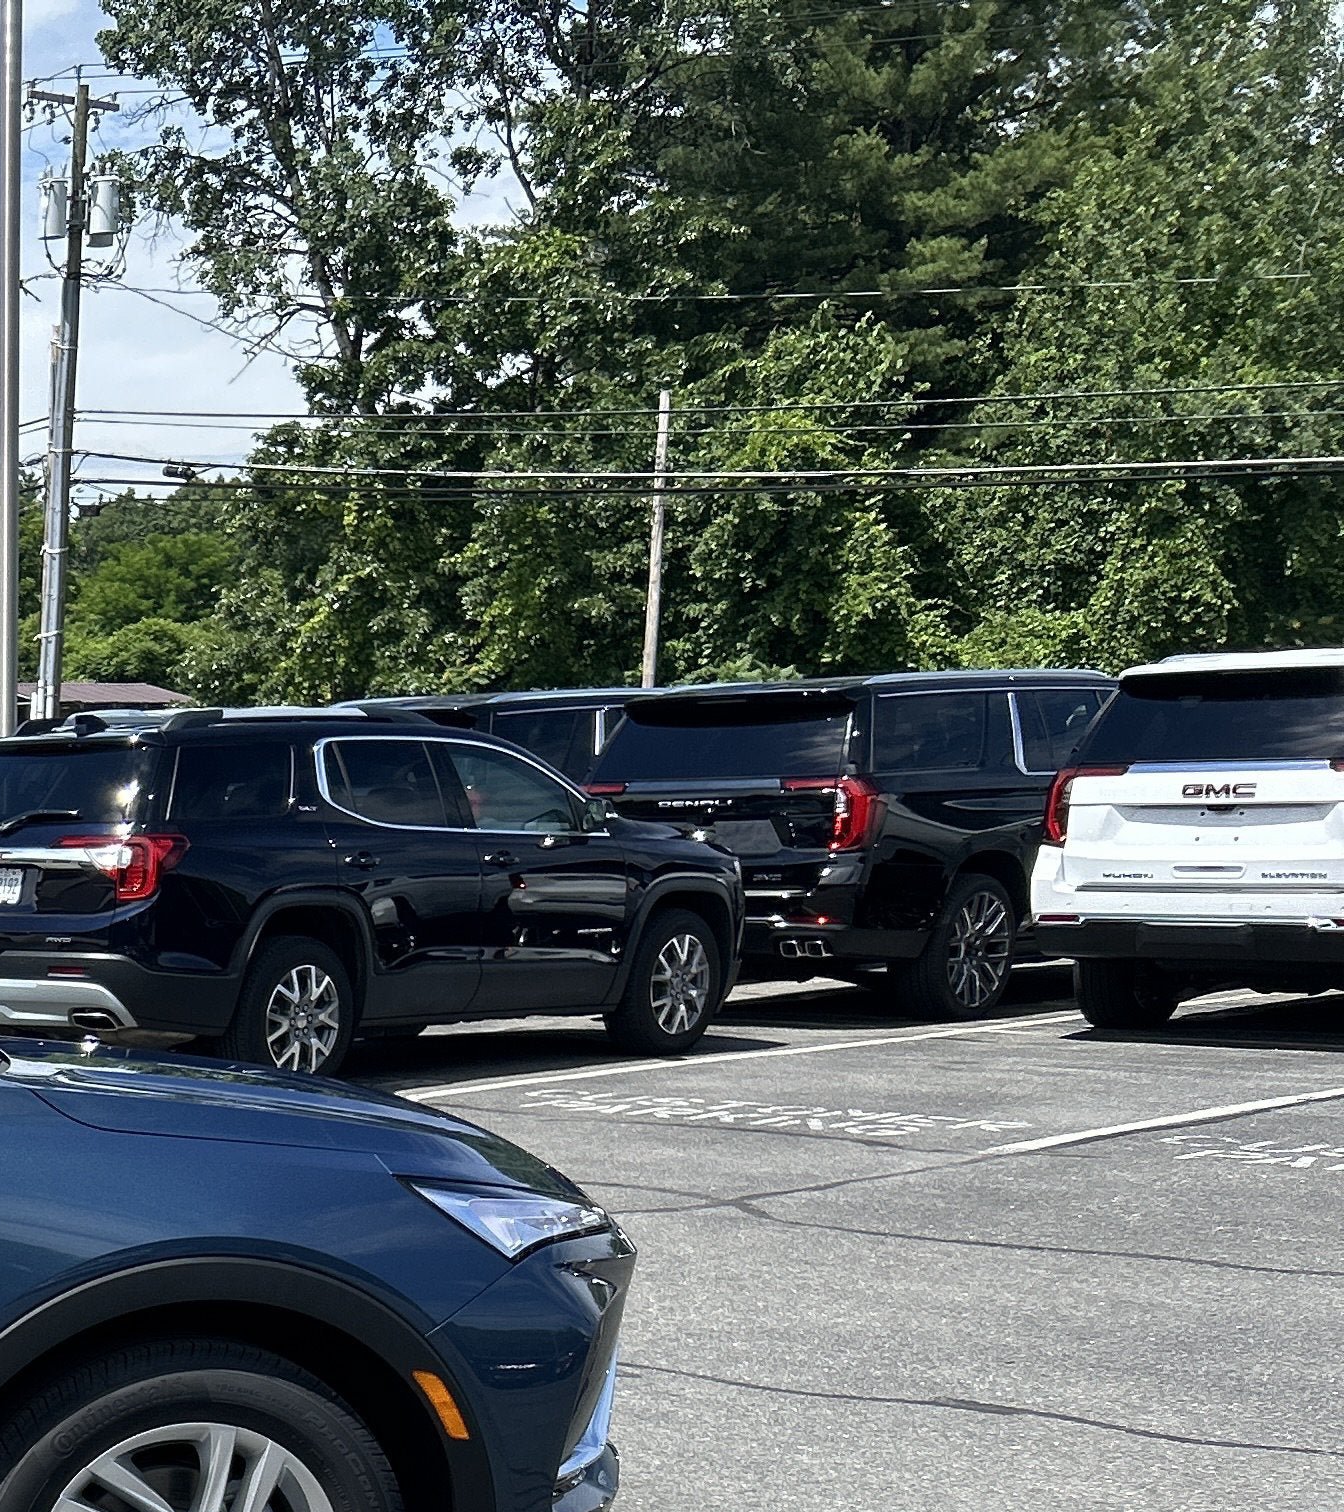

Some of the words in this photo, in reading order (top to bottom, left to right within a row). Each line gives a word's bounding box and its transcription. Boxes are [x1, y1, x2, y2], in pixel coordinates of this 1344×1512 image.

[1181, 783, 1257, 798] GMC
[518, 1100, 921, 1137] PARKING
[524, 1088, 1033, 1132] CUSTOMER
